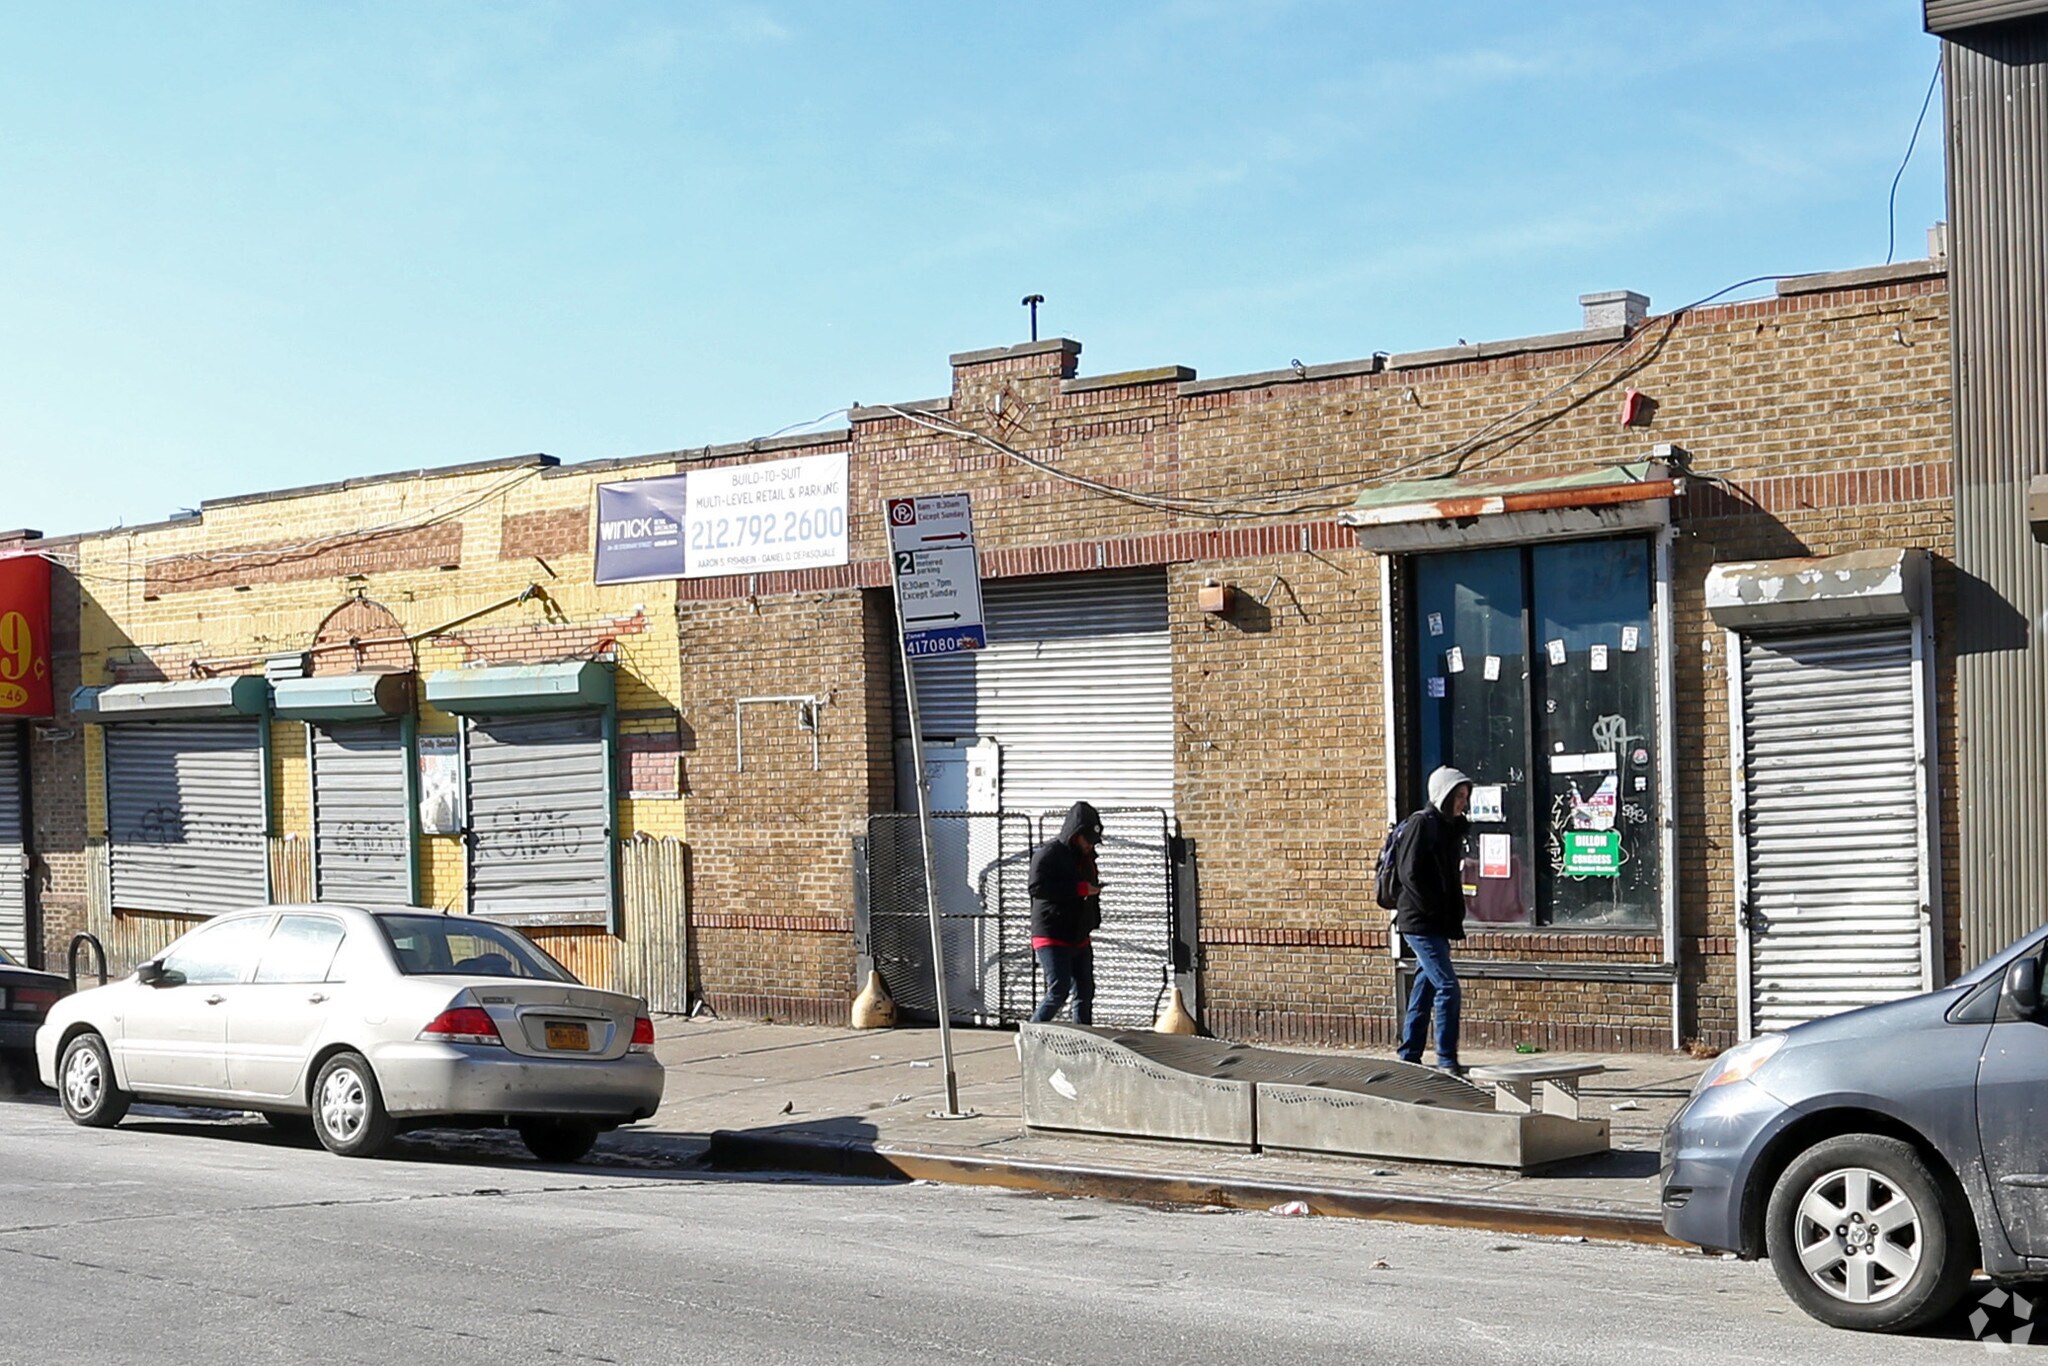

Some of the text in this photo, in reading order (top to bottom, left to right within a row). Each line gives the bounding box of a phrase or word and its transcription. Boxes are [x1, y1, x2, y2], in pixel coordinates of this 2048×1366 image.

[732, 466, 801, 486] BUILD-TO-SUIT
[696, 482, 840, 508] MULTI-LEVEL RETAIL & PARKING
[941, 511, 965, 520] Sunday
[691, 506, 843, 550] 212.792.2600
[898, 552, 913, 574] 2
[916, 558, 943, 567] metered
[917, 566, 940, 575] parking
[901, 581, 930, 591] 8:30am
[936, 578, 952, 588] 7pm
[902, 588, 957, 600] Except Sunday
[906, 637, 955, 654] 417080
[1575, 834, 1607, 847] DILLON
